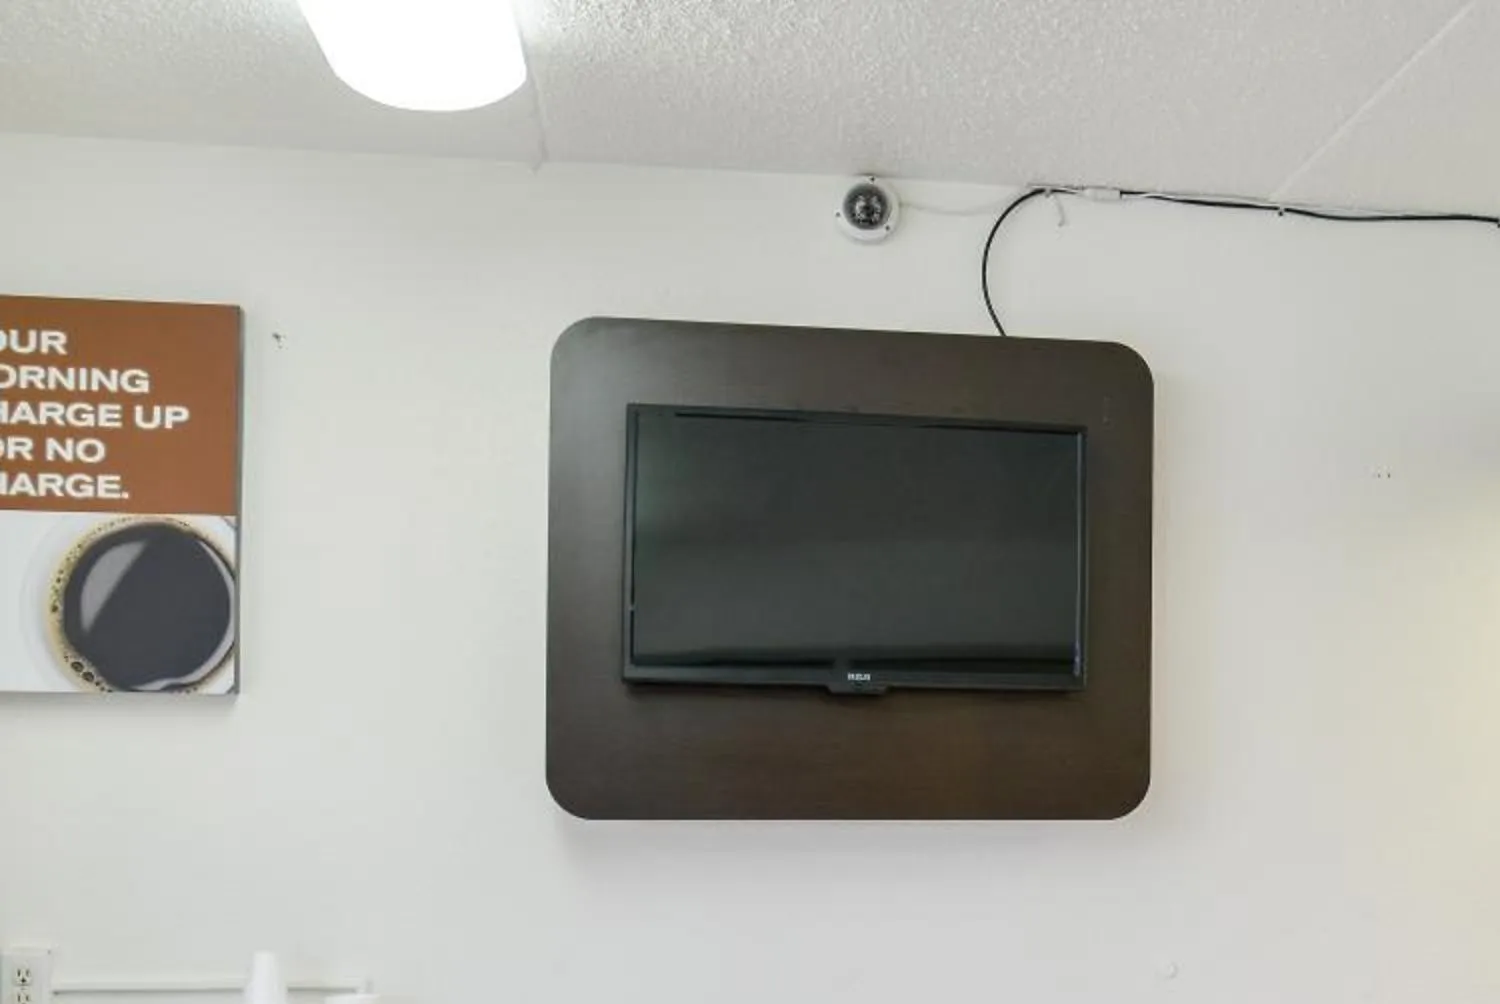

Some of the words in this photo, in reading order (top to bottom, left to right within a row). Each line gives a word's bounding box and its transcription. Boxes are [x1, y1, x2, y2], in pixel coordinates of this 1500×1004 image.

[0, 329, 67, 355] UR
[134, 404, 190, 429] UP
[0, 436, 34, 460] R
[45, 437, 106, 463] NO
[0, 471, 130, 499] ARGE.
